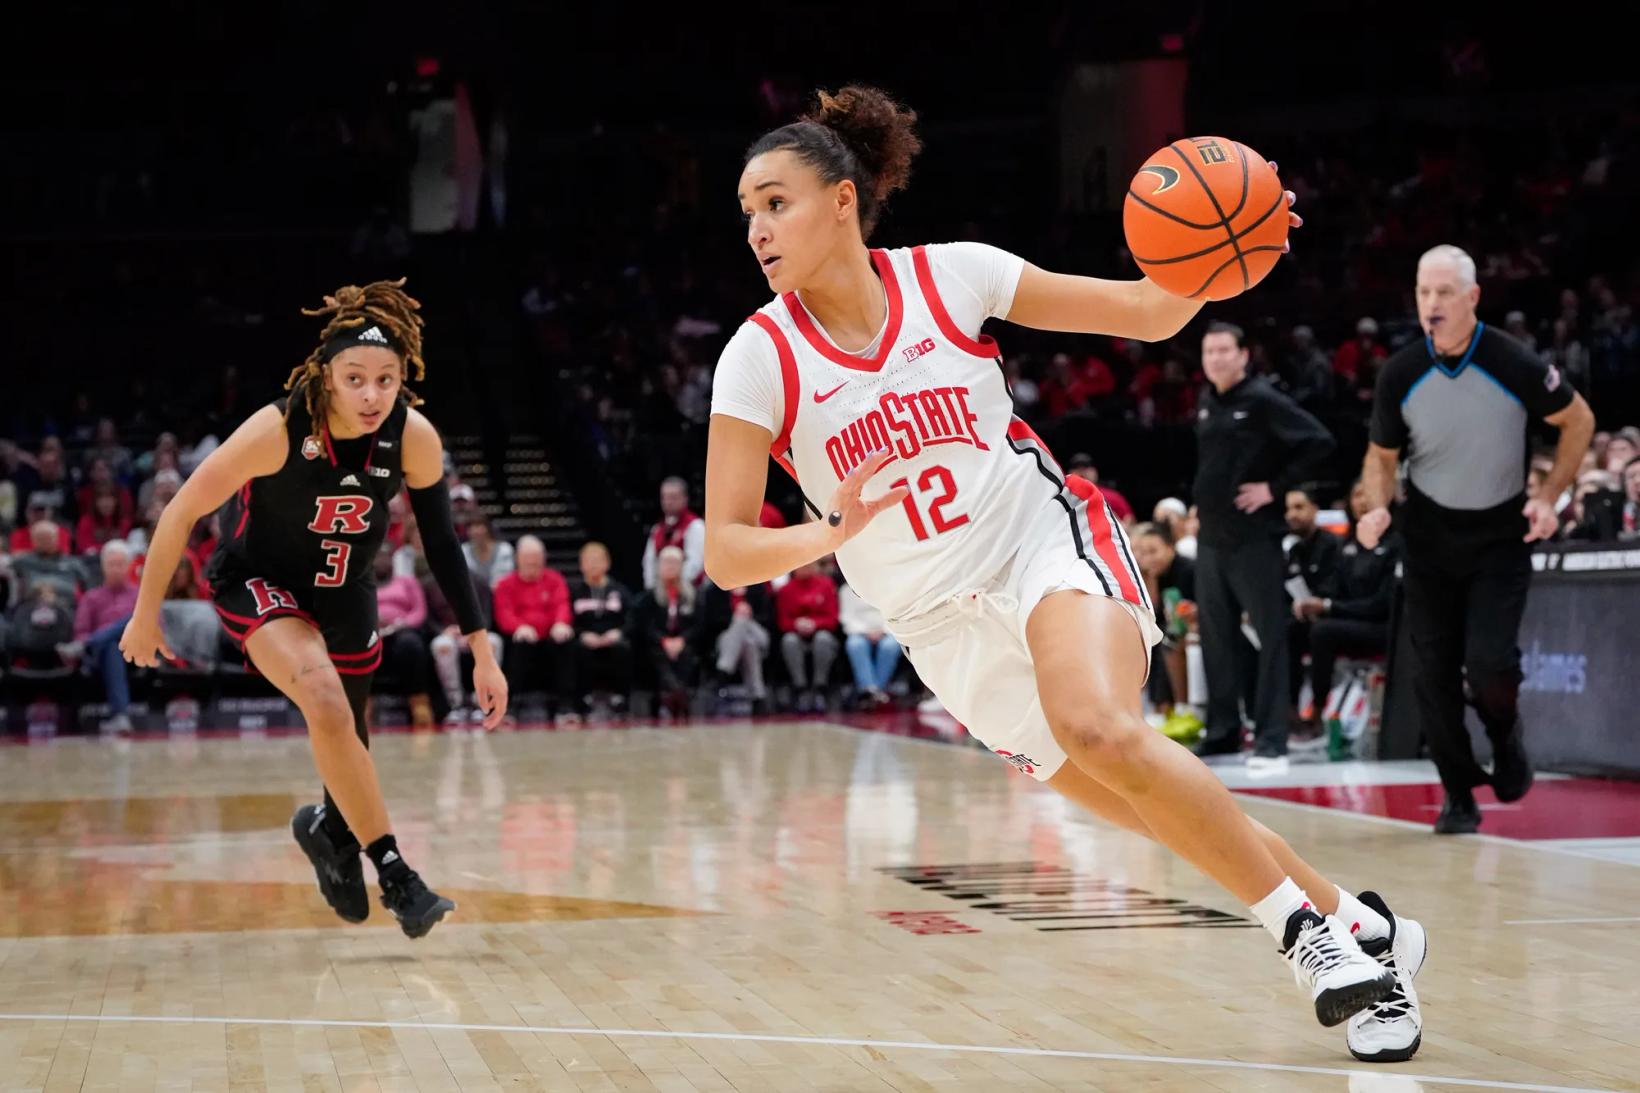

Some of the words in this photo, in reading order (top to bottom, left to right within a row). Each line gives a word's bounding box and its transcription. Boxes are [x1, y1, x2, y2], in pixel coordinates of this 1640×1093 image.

[825, 410, 894, 482] OHIO
[879, 386, 991, 460] STATE
[307, 494, 373, 534] R
[889, 464, 970, 542] 12
[314, 539, 351, 588] 3
